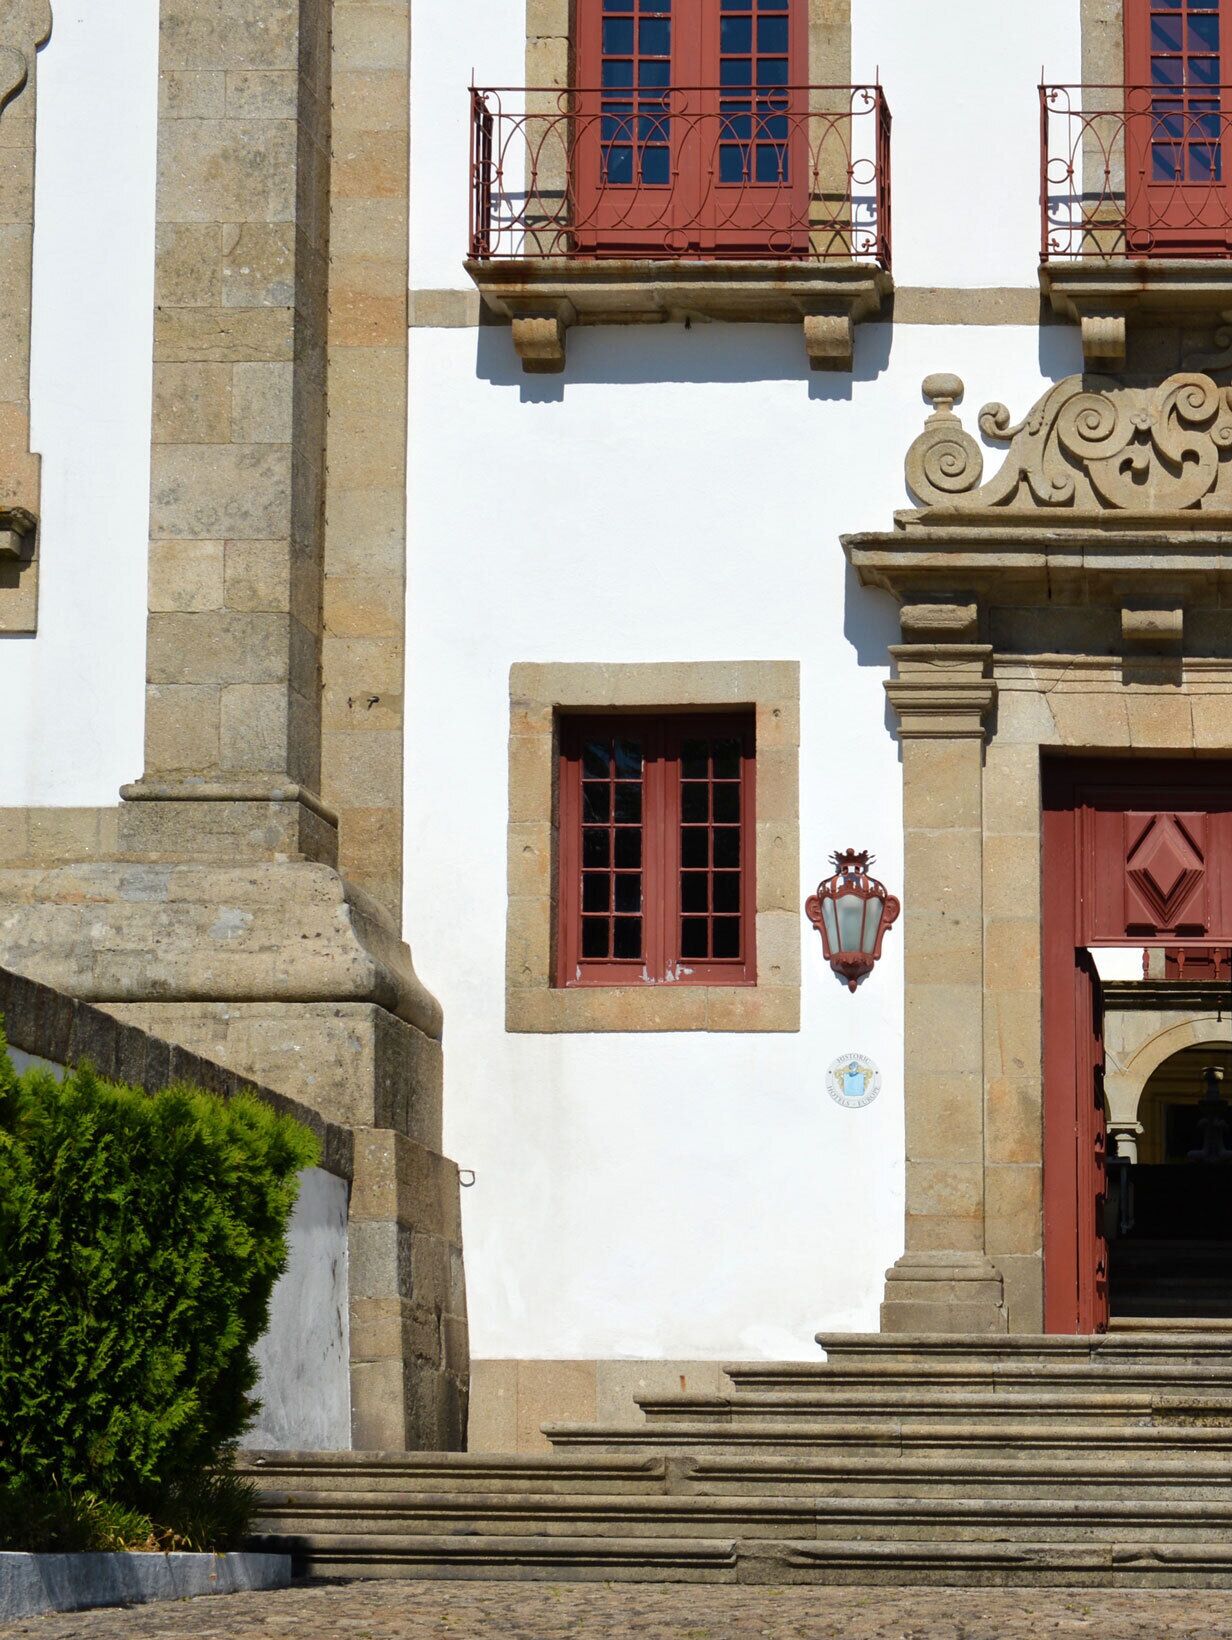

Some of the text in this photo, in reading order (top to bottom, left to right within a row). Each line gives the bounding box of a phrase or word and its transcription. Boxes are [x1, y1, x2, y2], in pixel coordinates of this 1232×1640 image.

[837, 1053, 872, 1064] HISTORIC
[827, 1085, 880, 1106] HOTELS EUROPE
